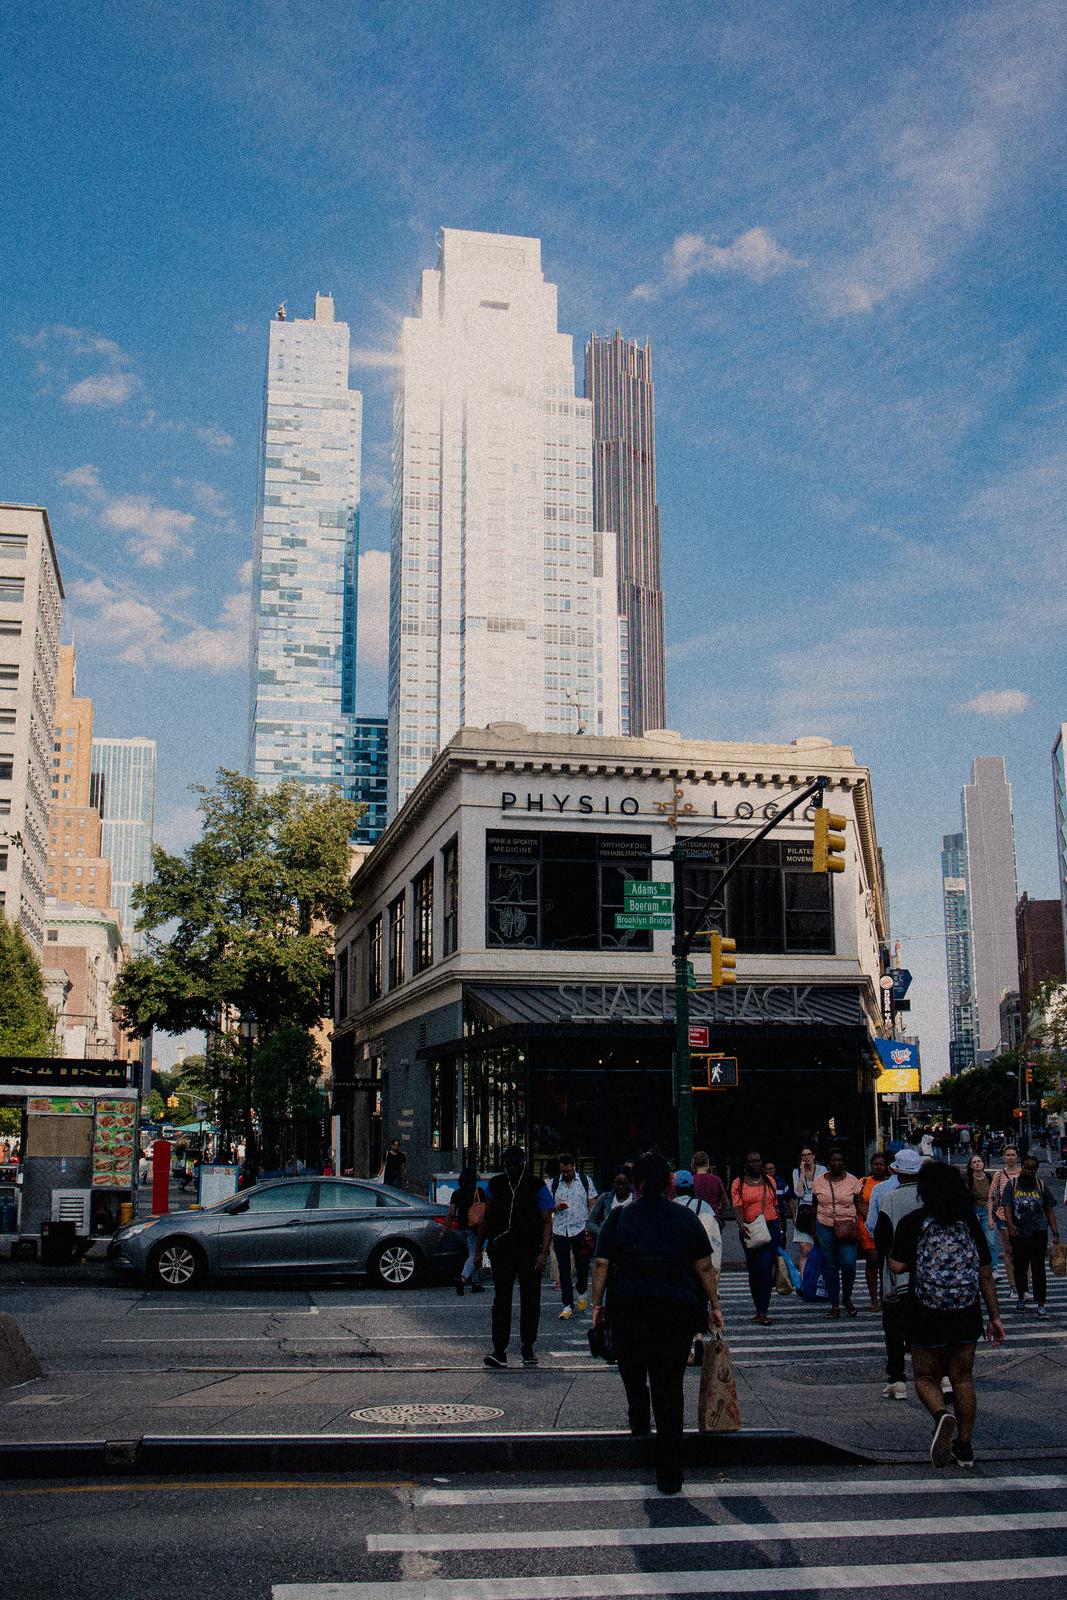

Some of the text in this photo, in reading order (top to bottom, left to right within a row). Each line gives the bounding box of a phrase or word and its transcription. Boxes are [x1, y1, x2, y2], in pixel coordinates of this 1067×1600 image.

[502, 792, 640, 816] PHYSIO
[513, 838, 538, 846] SPORTS
[600, 842, 647, 850] ORTHOPEDIC
[494, 846, 532, 854] MEDICINE
[632, 883, 658, 894] Adams
[629, 899, 660, 911] Boerum
[616, 915, 672, 926] Brooklyn Bridge
[689, 985, 815, 1018] SHACK
